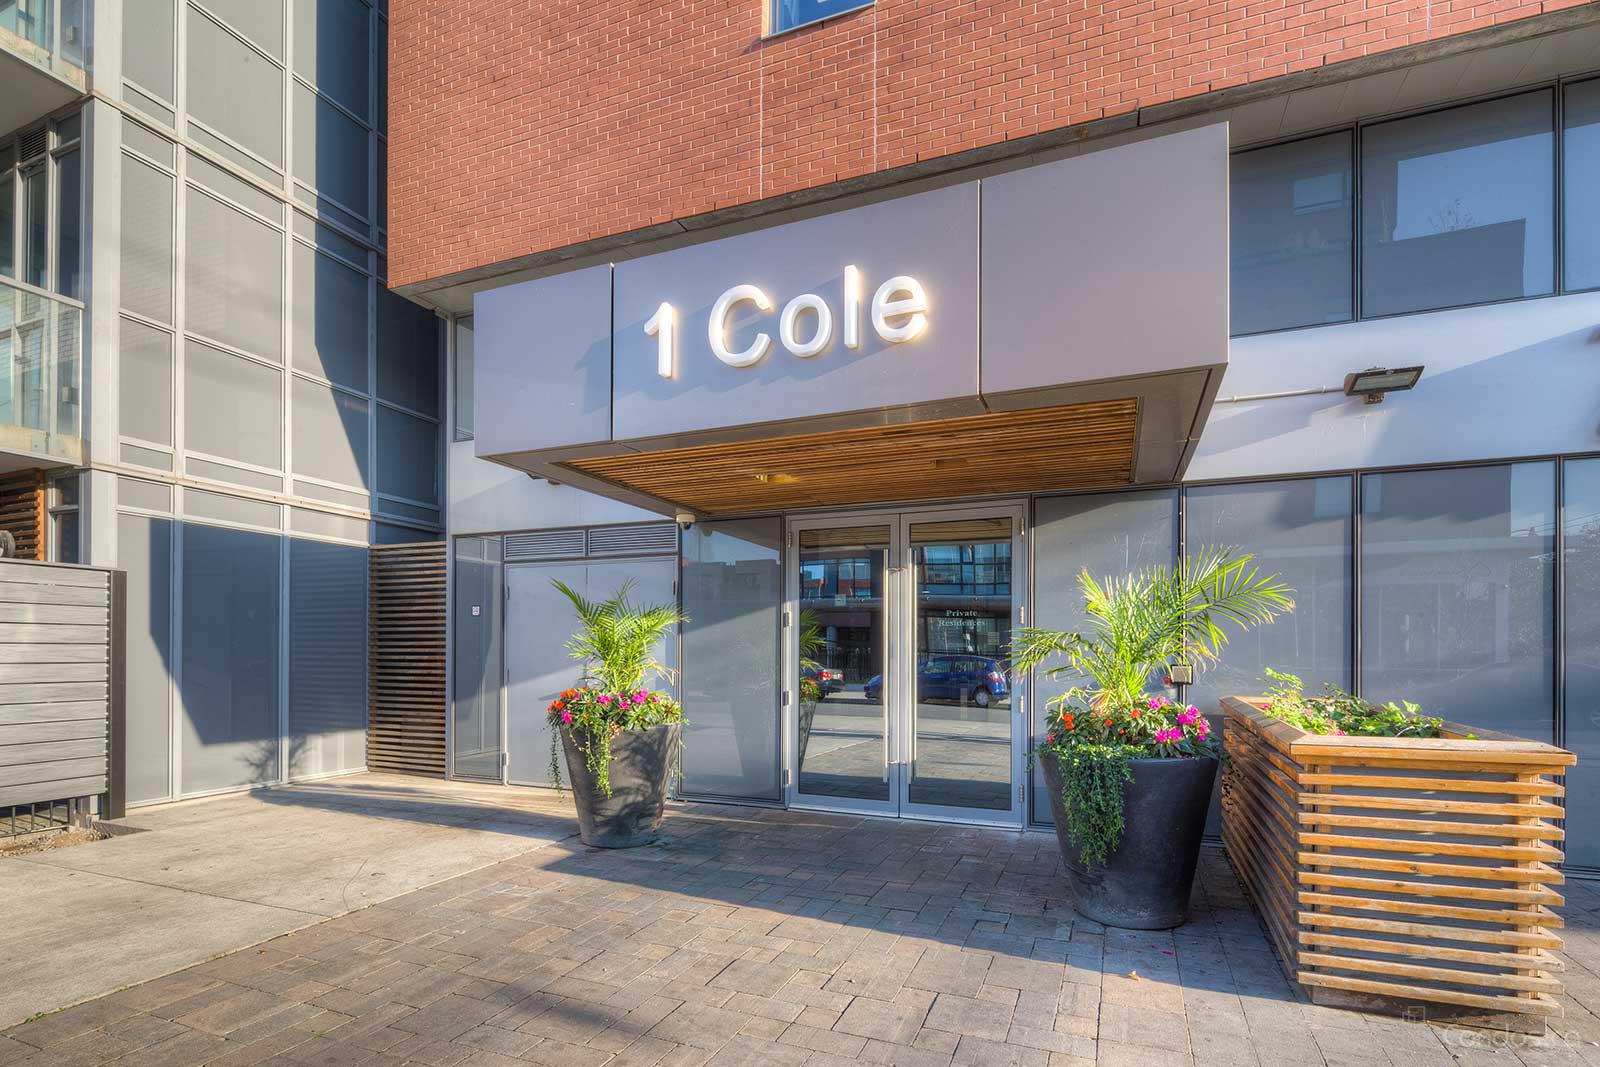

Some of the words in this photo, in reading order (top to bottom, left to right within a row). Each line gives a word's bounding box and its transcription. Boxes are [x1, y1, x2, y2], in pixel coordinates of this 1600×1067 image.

[644, 301, 674, 378] 1
[708, 264, 928, 368] Cole
[946, 609, 978, 617] Private
[938, 619, 986, 627] Residences
